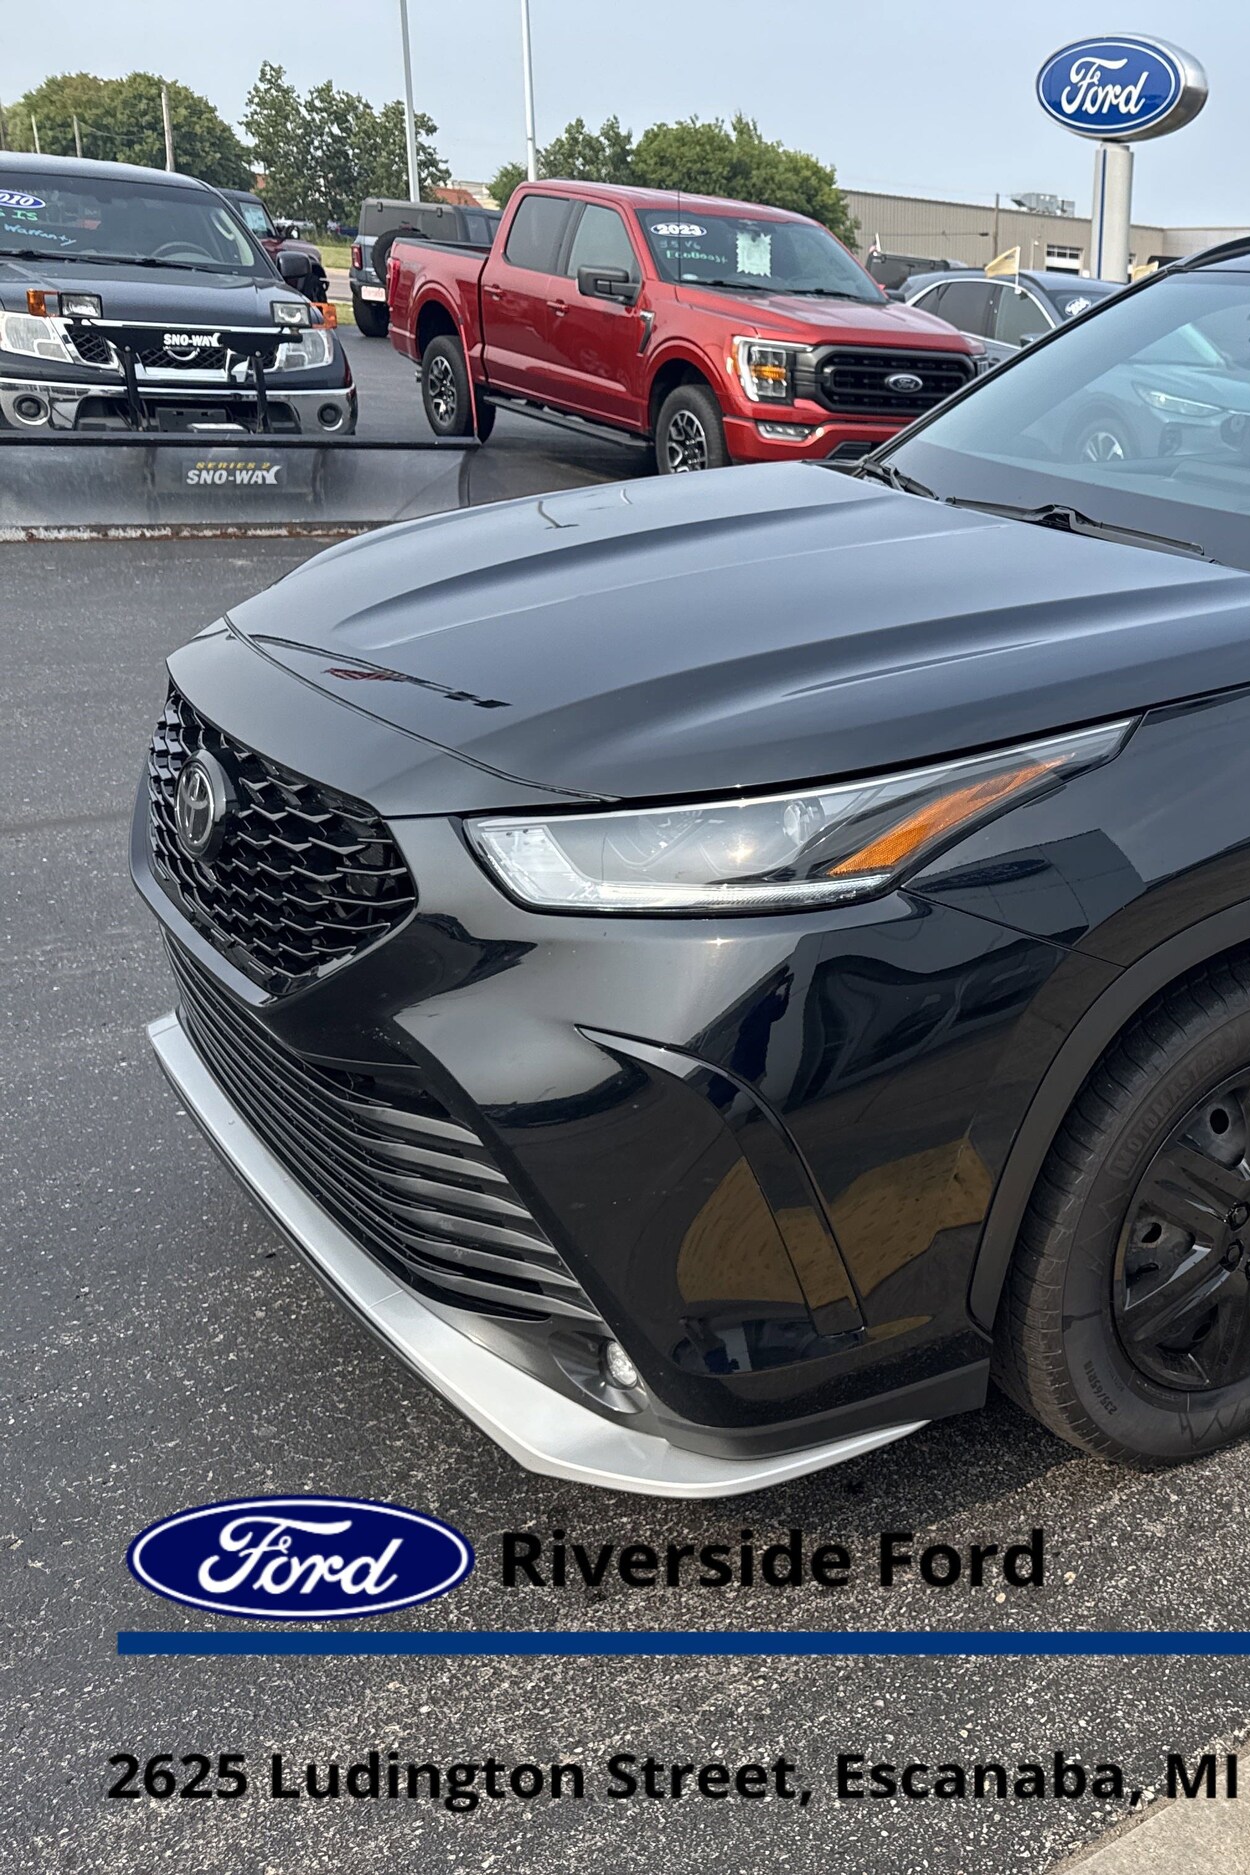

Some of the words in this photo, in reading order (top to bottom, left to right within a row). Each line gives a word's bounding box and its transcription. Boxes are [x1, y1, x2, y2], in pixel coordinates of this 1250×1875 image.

[1061, 57, 1149, 114] Ford
[0, 193, 35, 206] 010
[12, 209, 38, 221] IS
[4, 224, 76, 247] Warranty
[657, 224, 702, 236] 2023
[163, 332, 223, 347] SNO-WAY
[186, 465, 282, 485] SNO-WAY
